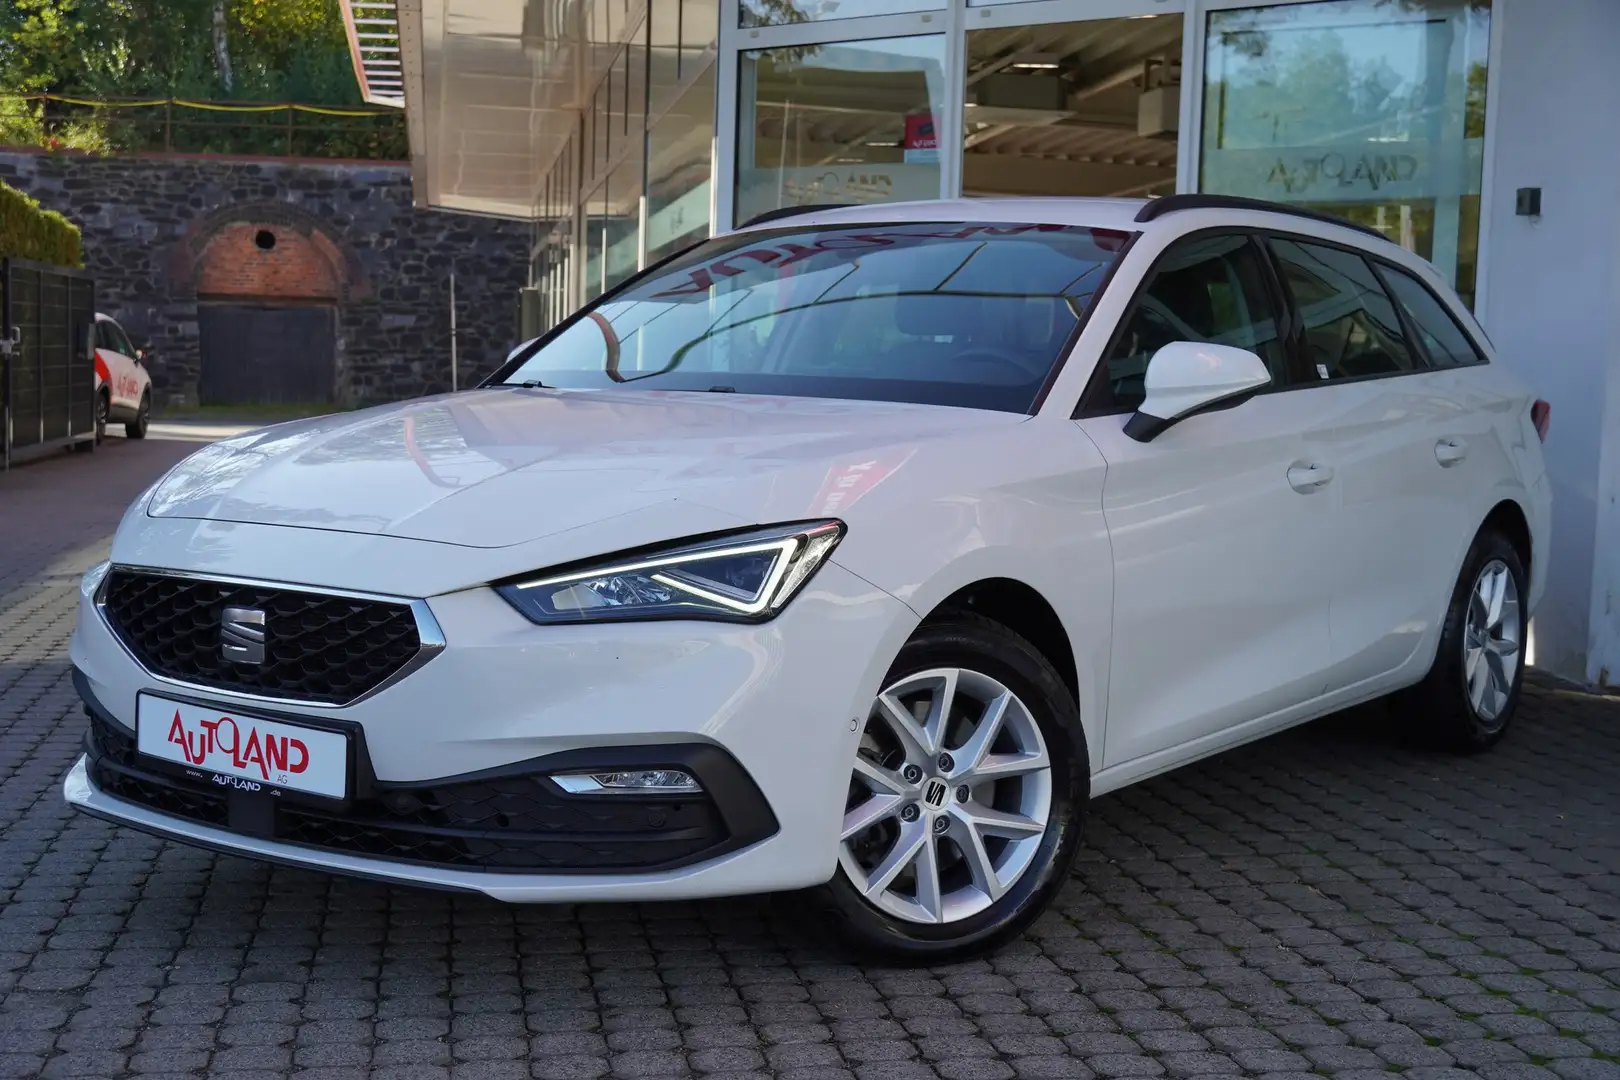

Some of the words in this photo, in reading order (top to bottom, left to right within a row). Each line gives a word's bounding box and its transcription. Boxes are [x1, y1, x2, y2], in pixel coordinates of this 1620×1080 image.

[167, 708, 310, 781] AUTOLAND
[212, 773, 261, 792] AUTOLAND
[277, 774, 288, 785] AG
